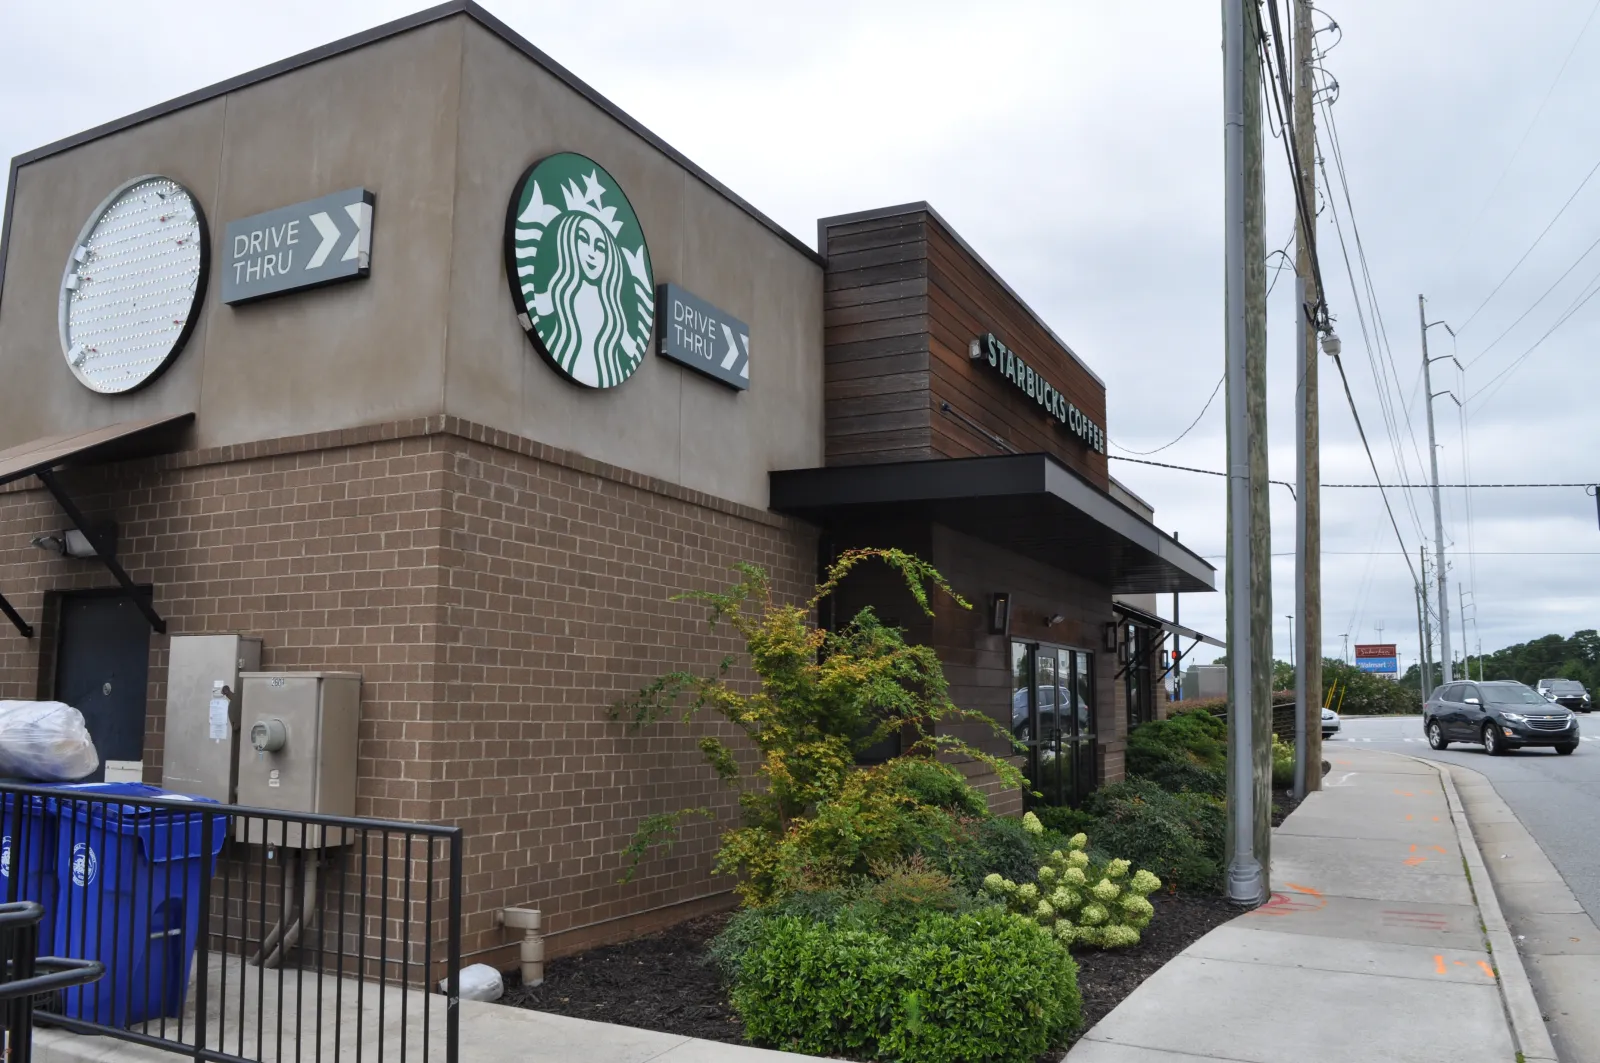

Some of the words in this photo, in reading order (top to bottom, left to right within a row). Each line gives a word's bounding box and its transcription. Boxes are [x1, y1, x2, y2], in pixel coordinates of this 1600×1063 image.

[234, 220, 299, 258] DRIVE
[233, 249, 292, 284] THRU
[674, 300, 716, 340] DRIVE
[674, 324, 713, 360] THRU
[987, 332, 1066, 424] STARBUCKS
[1068, 403, 1104, 455] COFFEE
